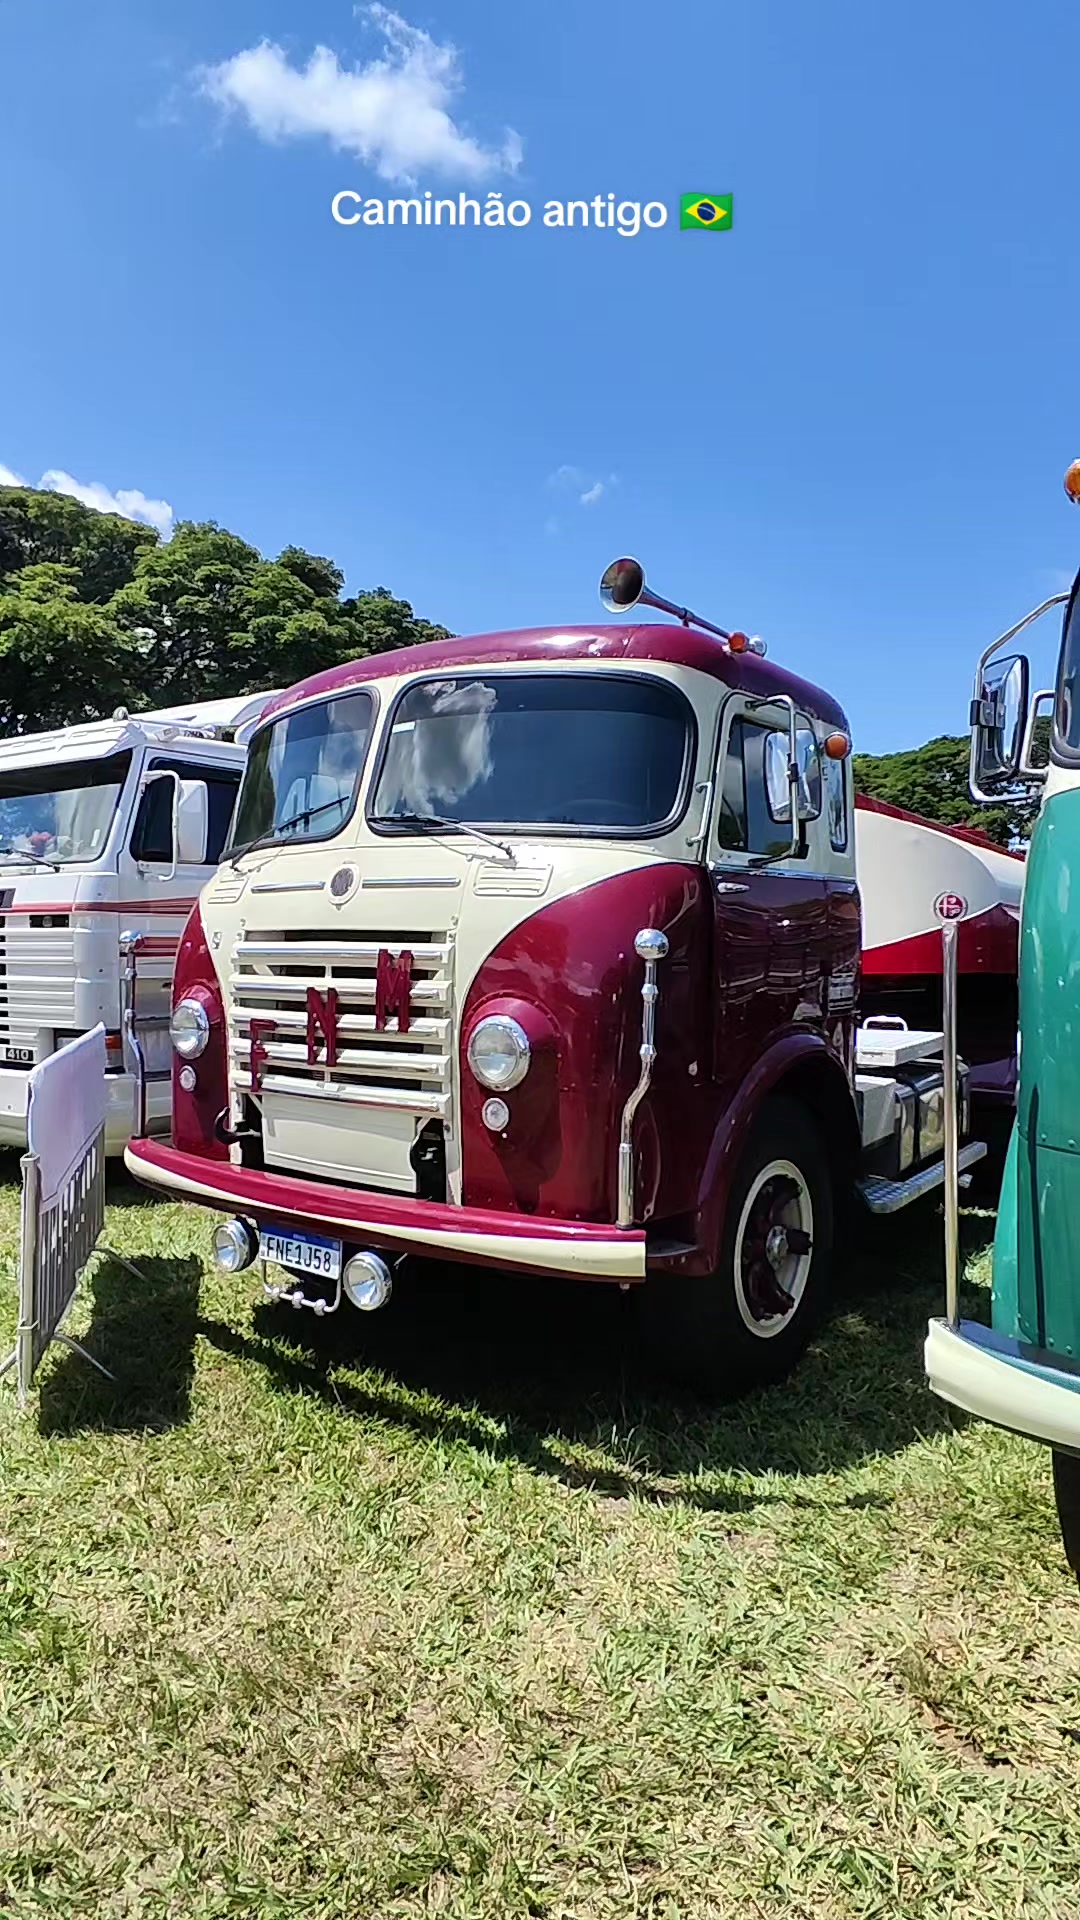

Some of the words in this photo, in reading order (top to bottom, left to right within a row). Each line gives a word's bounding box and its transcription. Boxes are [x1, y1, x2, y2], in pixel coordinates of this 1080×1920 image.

[250, 948, 415, 1092] FNM
[7, 1048, 29, 1060] 410
[266, 1236, 332, 1273] FNE1J58
